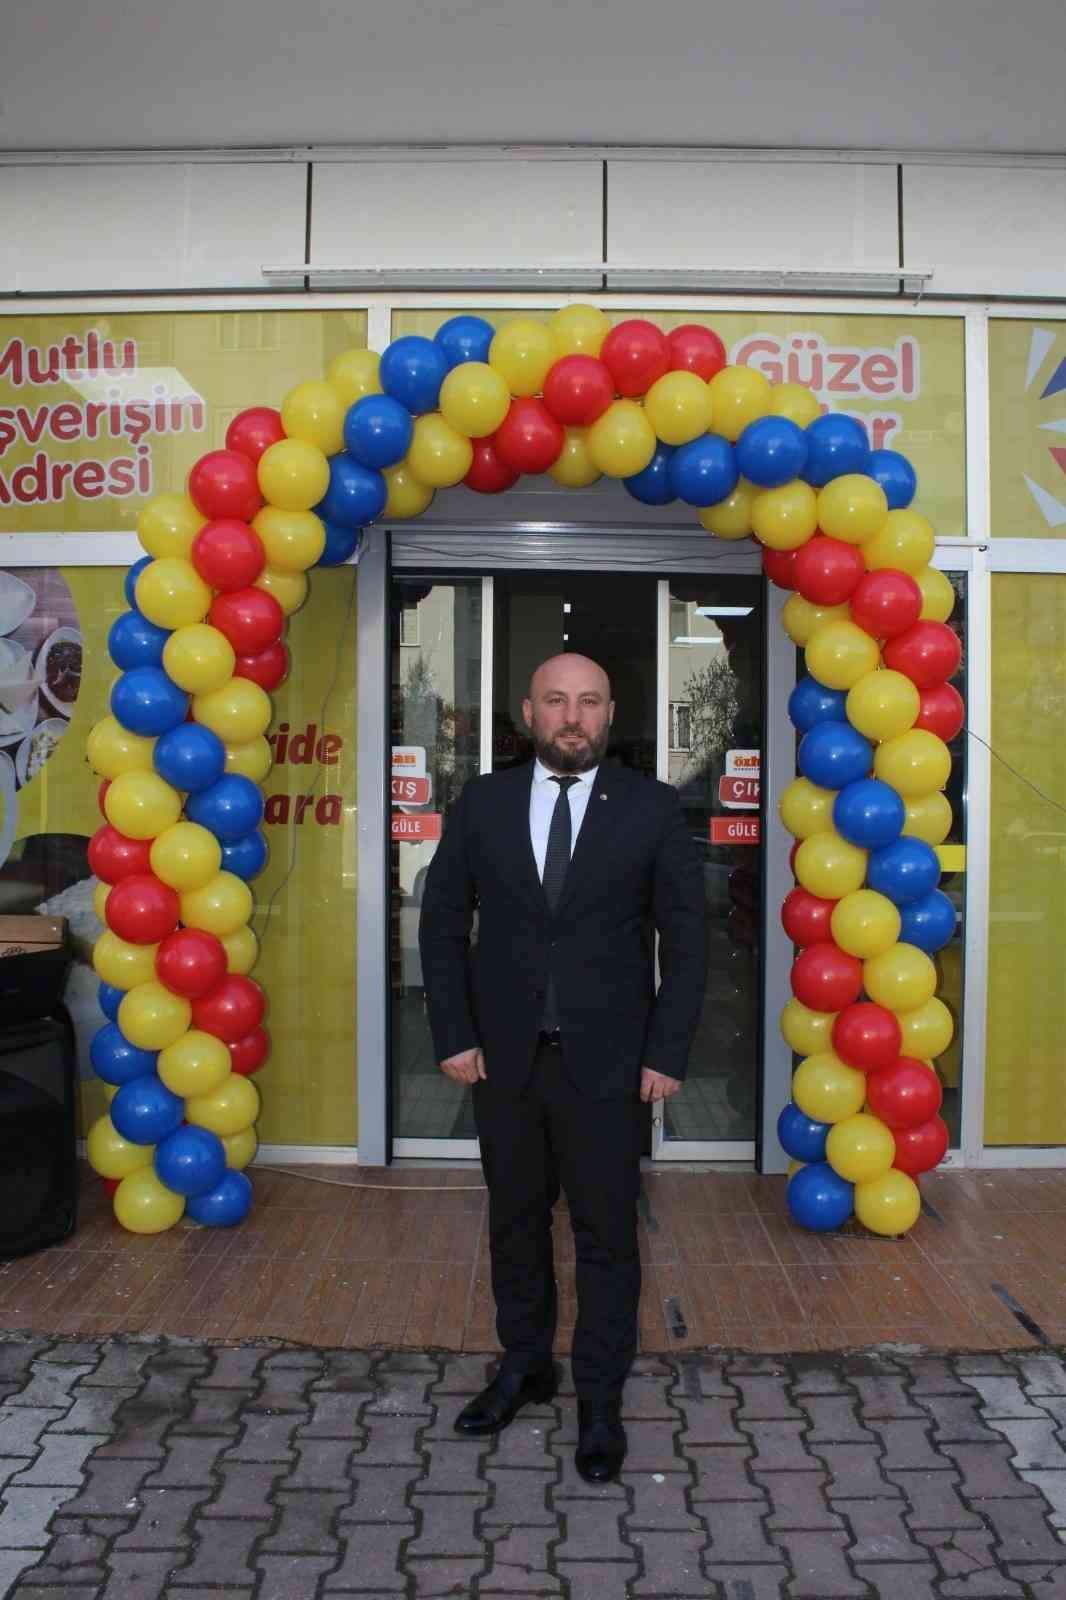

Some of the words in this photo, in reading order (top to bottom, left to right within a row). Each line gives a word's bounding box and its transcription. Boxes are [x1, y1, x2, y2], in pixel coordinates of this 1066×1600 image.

[735, 338, 914, 395] Güzel
[392, 818, 421, 833] GÜLE
[727, 821, 758, 837] GÜLE
